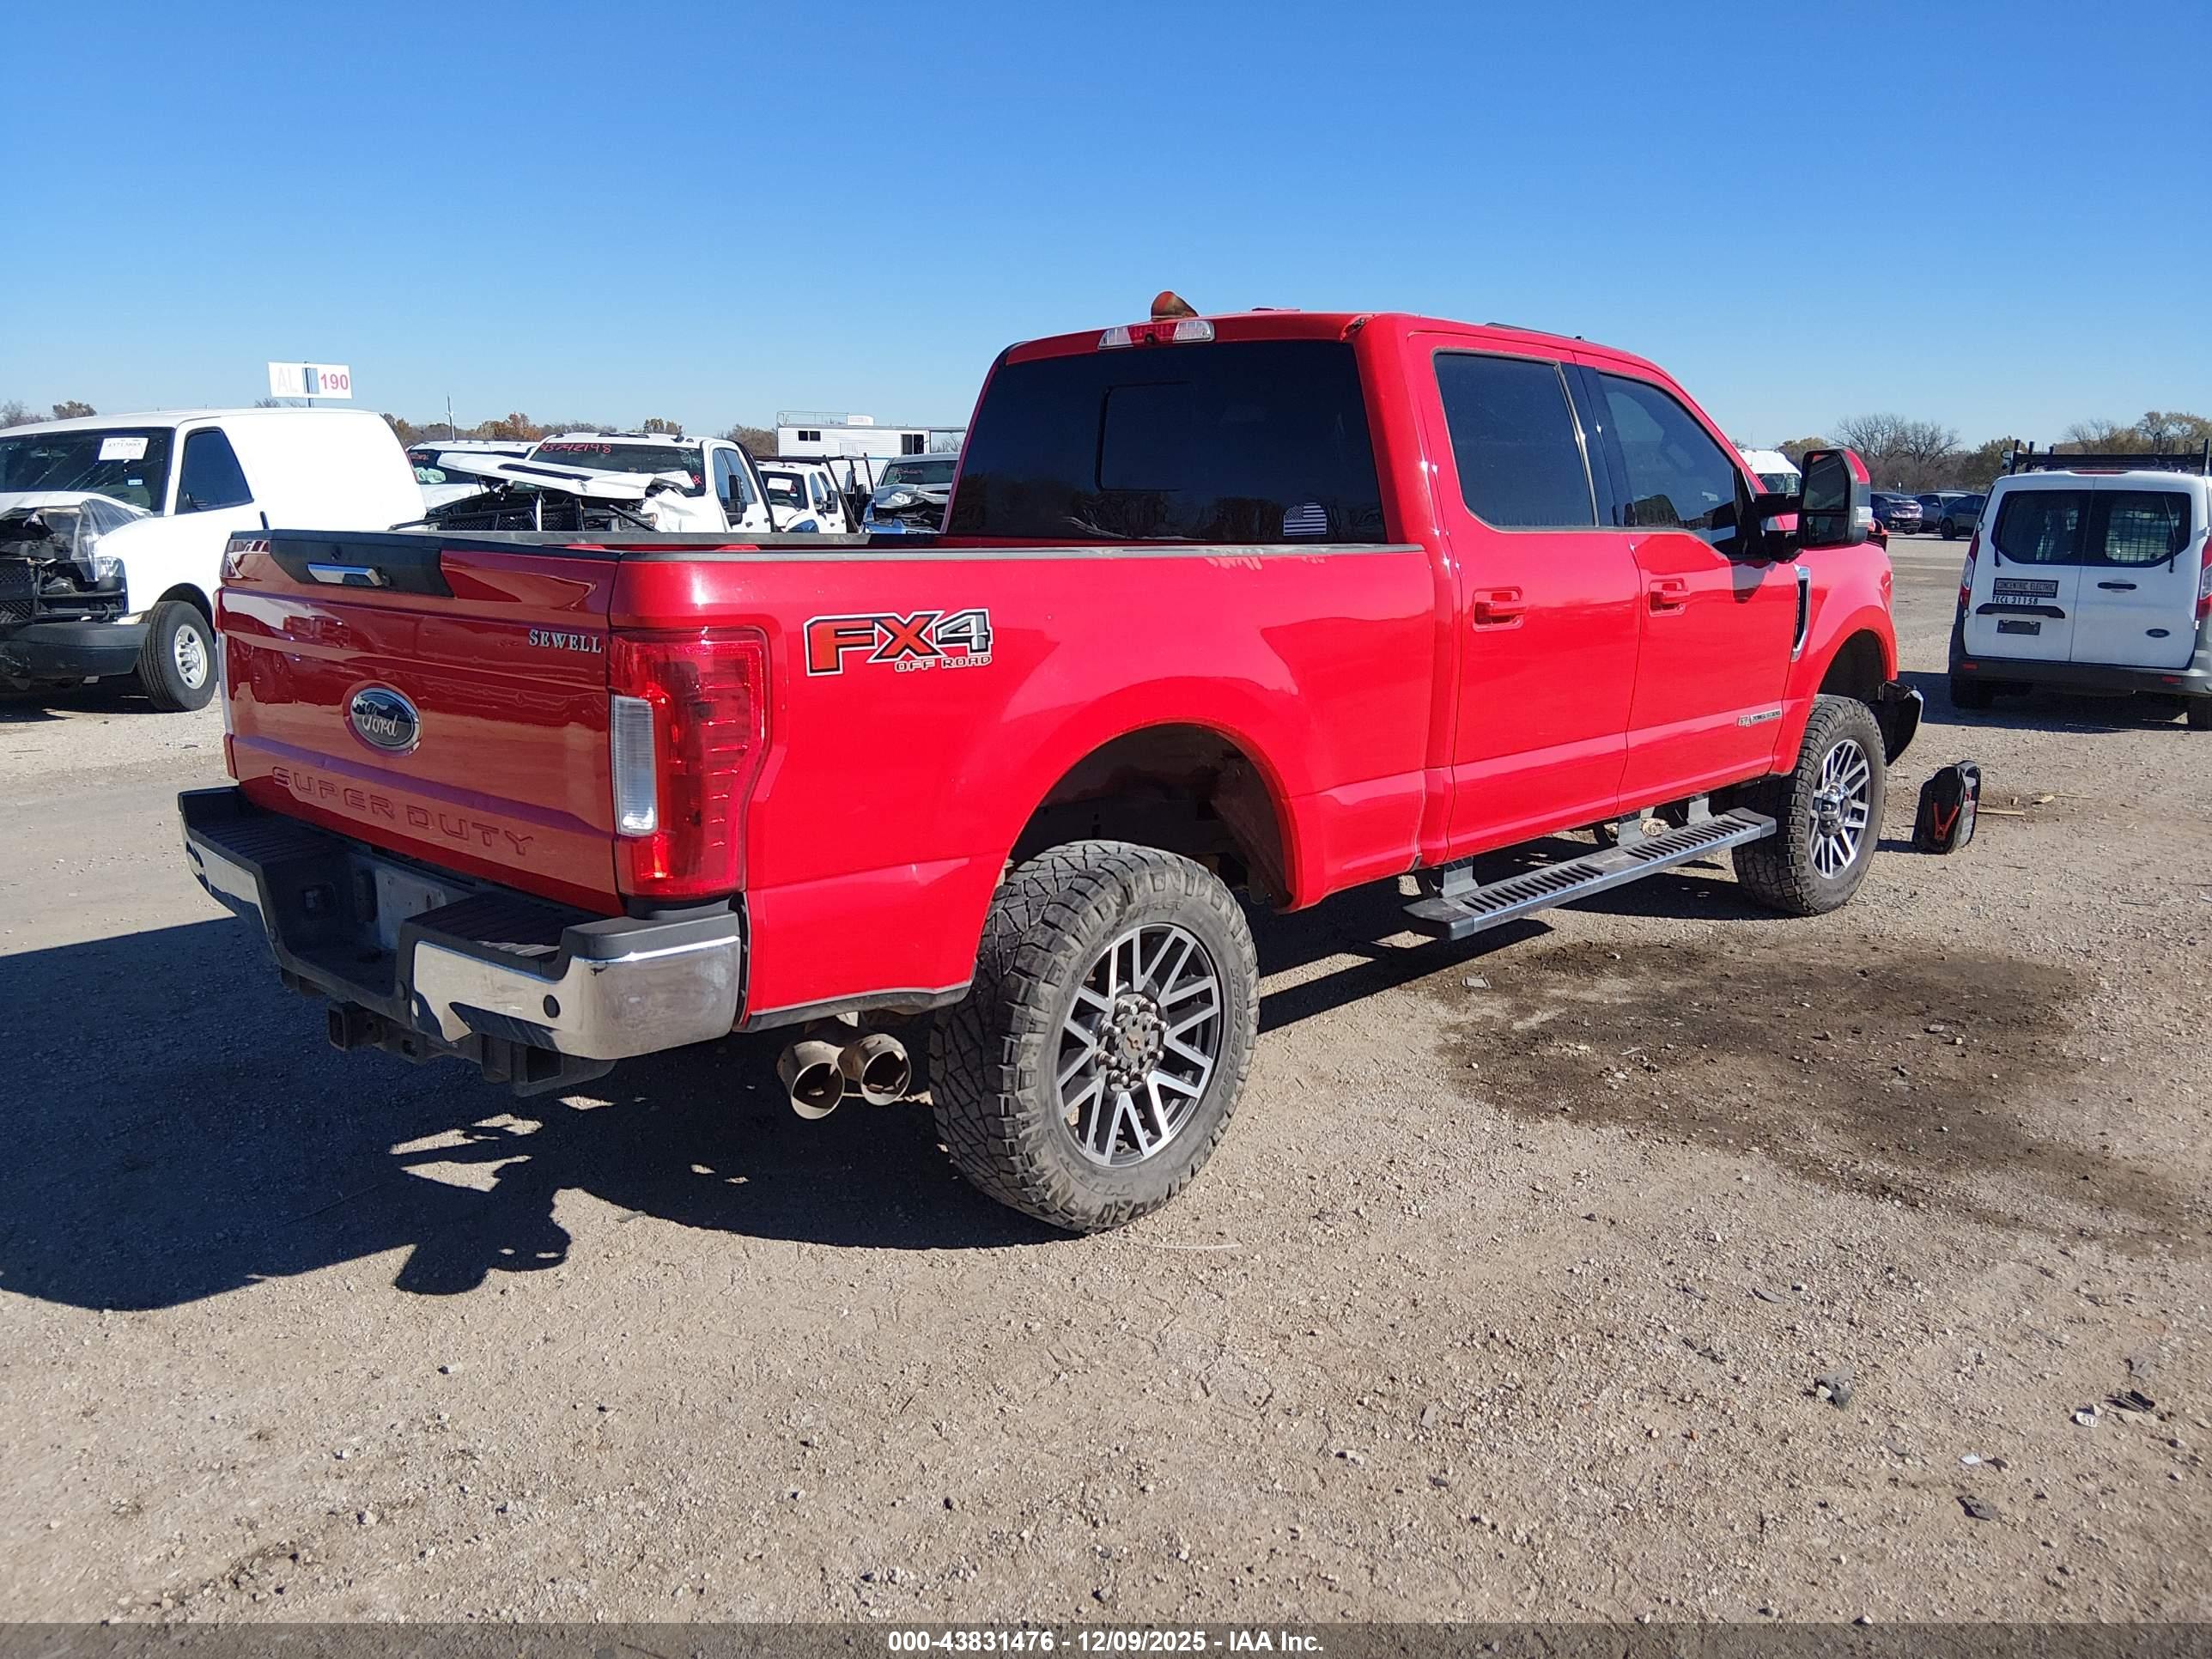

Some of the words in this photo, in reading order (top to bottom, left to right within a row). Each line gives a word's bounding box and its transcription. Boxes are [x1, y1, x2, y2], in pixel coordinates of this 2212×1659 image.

[320, 374, 349, 390] 190
[528, 629, 602, 653] SEWELL
[803, 608, 994, 677] FX4
[895, 658, 935, 672] OFF
[942, 654, 994, 669] ROAD
[361, 700, 399, 737] Ford
[271, 766, 396, 820] SUPER
[405, 804, 534, 856] DUTY
